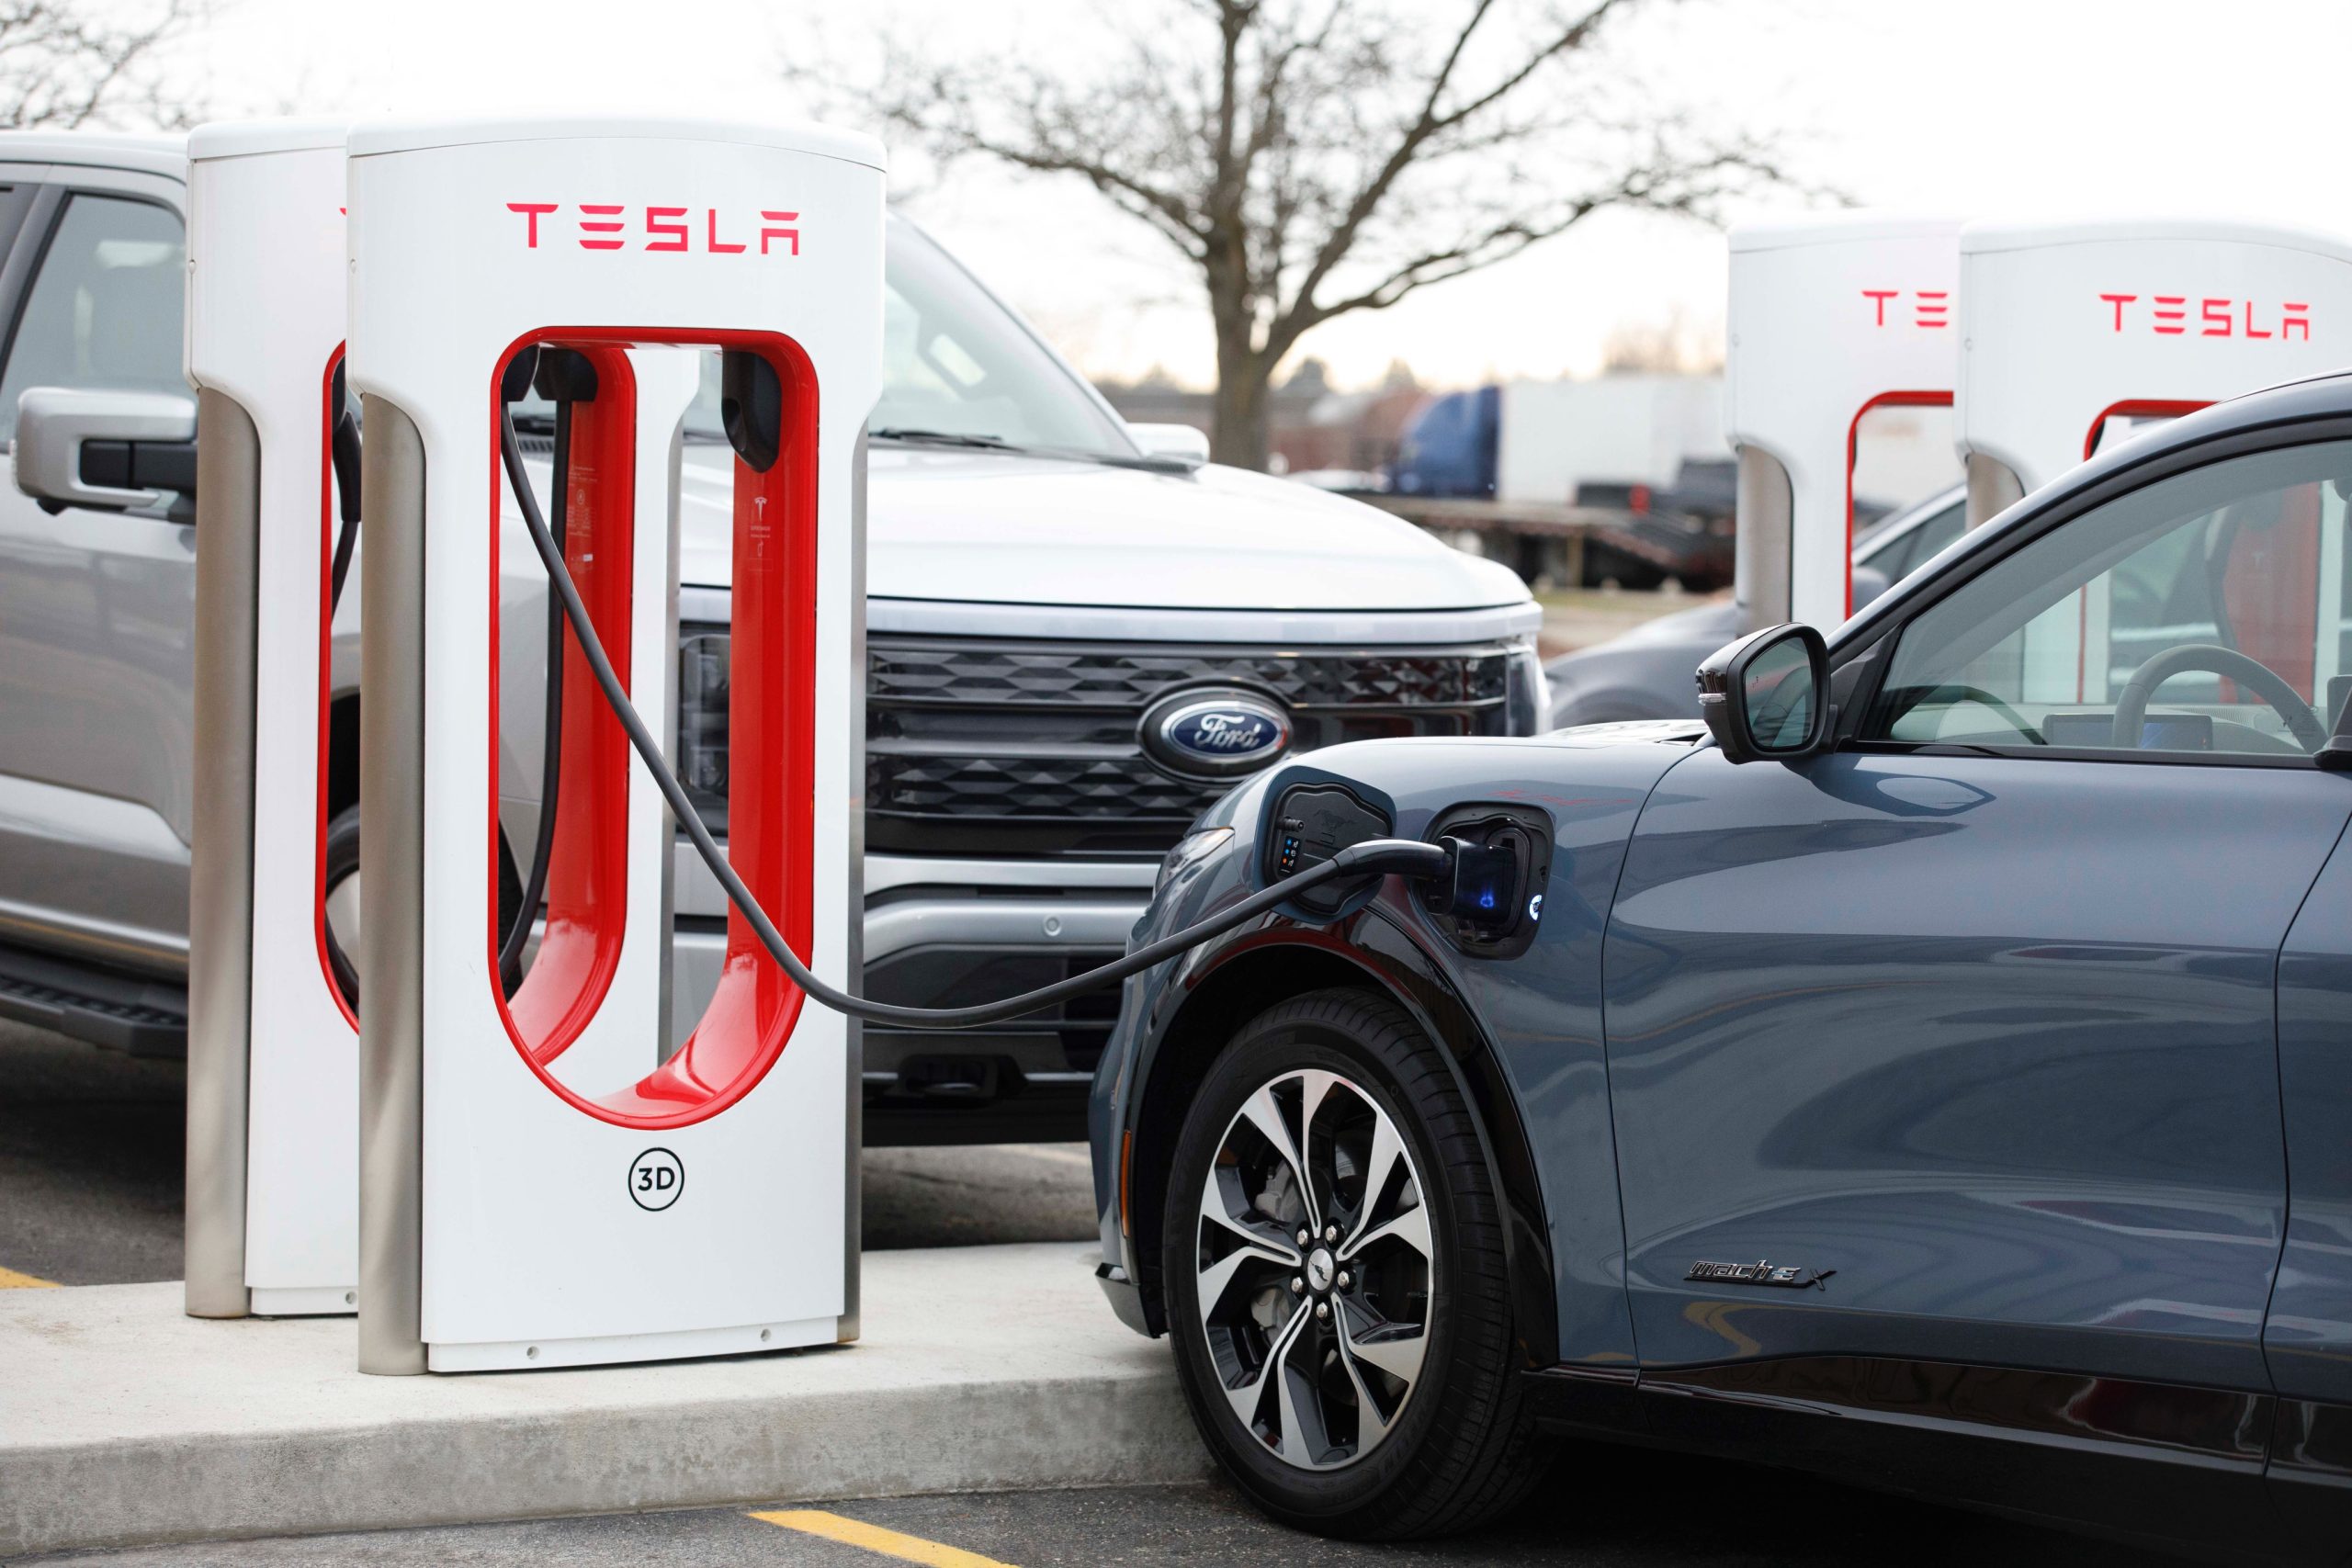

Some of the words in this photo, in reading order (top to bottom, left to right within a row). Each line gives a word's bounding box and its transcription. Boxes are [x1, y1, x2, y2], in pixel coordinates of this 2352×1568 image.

[505, 203, 799, 256] TESLA
[2098, 294, 2310, 342] TESLA
[1194, 713, 1261, 749] Ford
[638, 1167, 675, 1191] 3D
